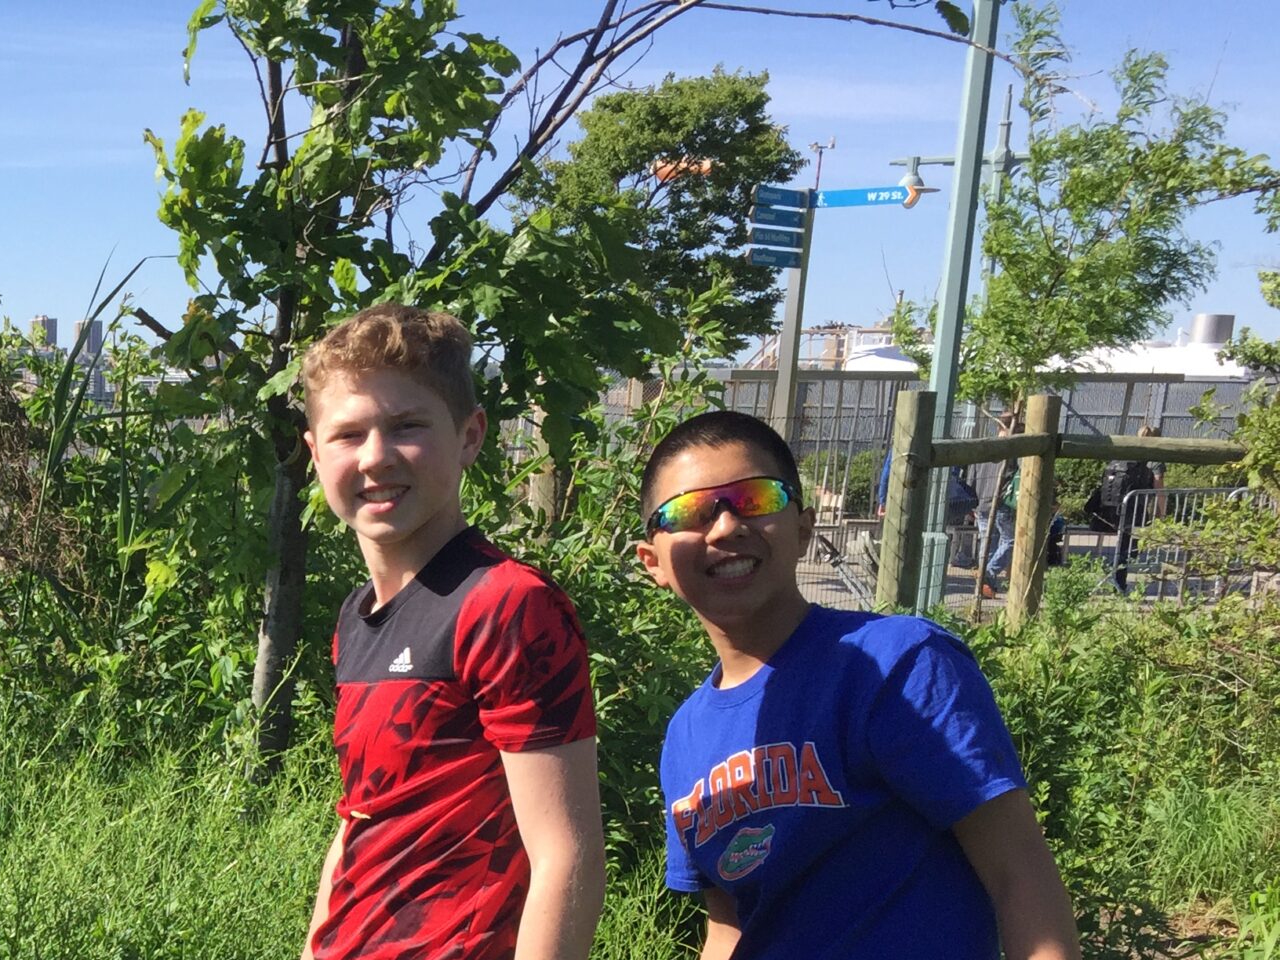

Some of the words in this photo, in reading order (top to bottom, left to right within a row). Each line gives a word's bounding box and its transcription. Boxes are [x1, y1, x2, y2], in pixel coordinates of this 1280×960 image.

[867, 191, 876, 202] W
[878, 191, 890, 201] 29
[891, 190, 904, 200] St.
[670, 740, 847, 850] FLORIDA
